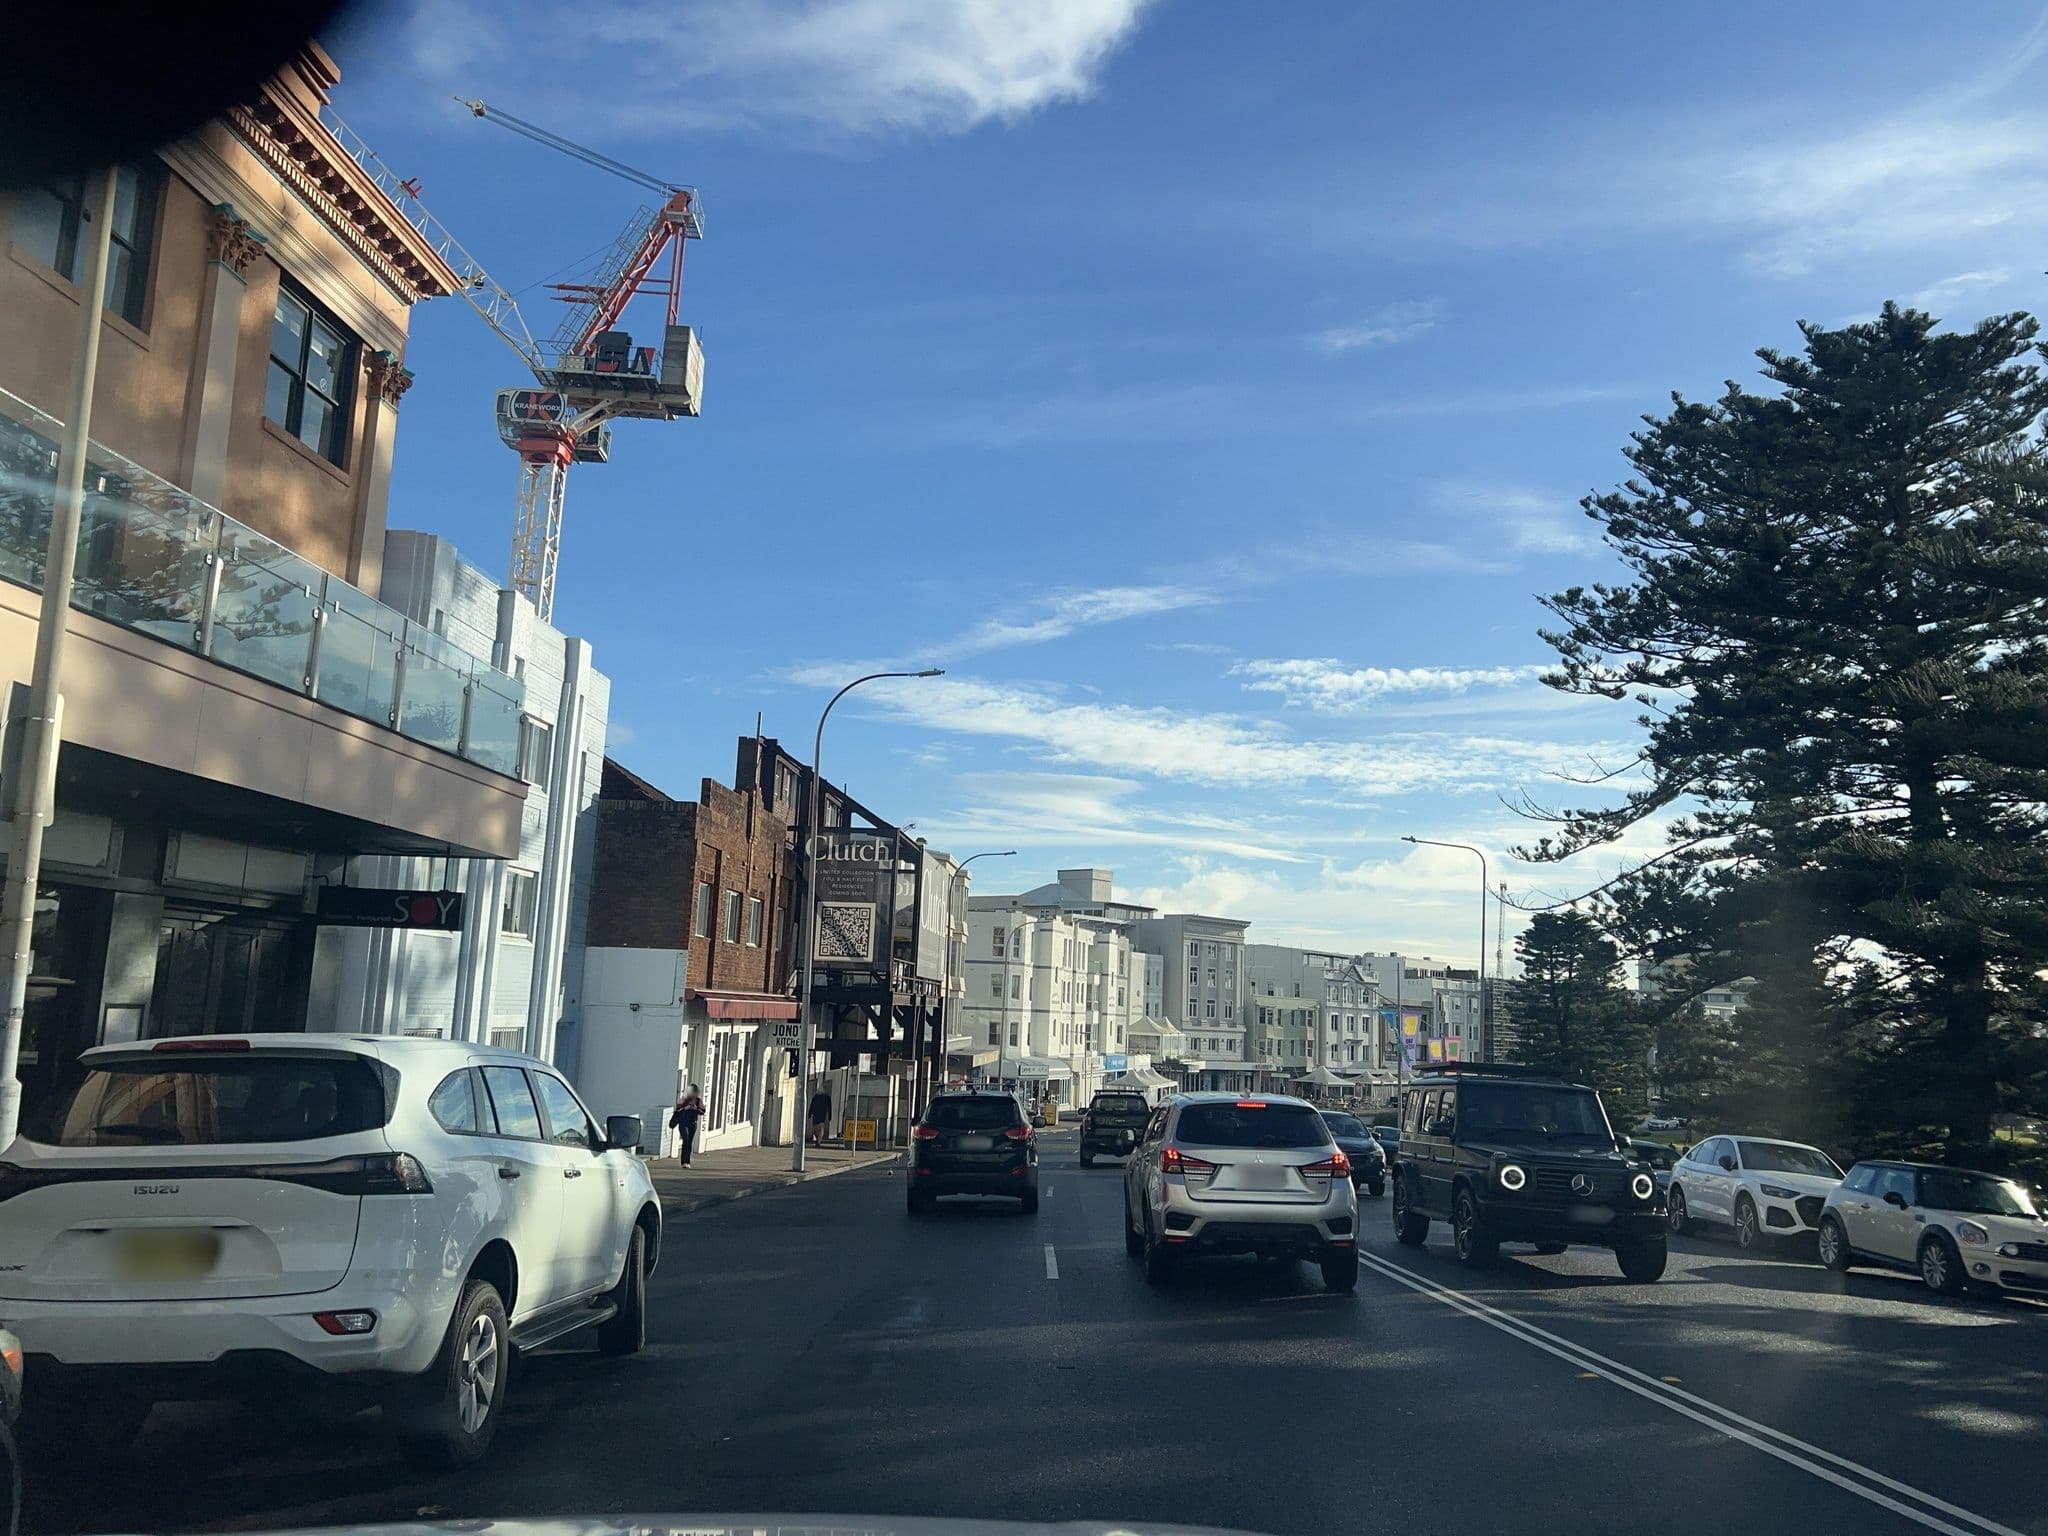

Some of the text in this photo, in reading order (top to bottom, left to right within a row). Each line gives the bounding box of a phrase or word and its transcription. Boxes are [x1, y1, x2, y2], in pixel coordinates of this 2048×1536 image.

[514, 402, 561, 411] KRANEWORX
[805, 835, 889, 862] Clutch
[772, 1024, 802, 1037] JONO'
[776, 1037, 801, 1047] KITCHE
[134, 1184, 180, 1195] ISUZU
